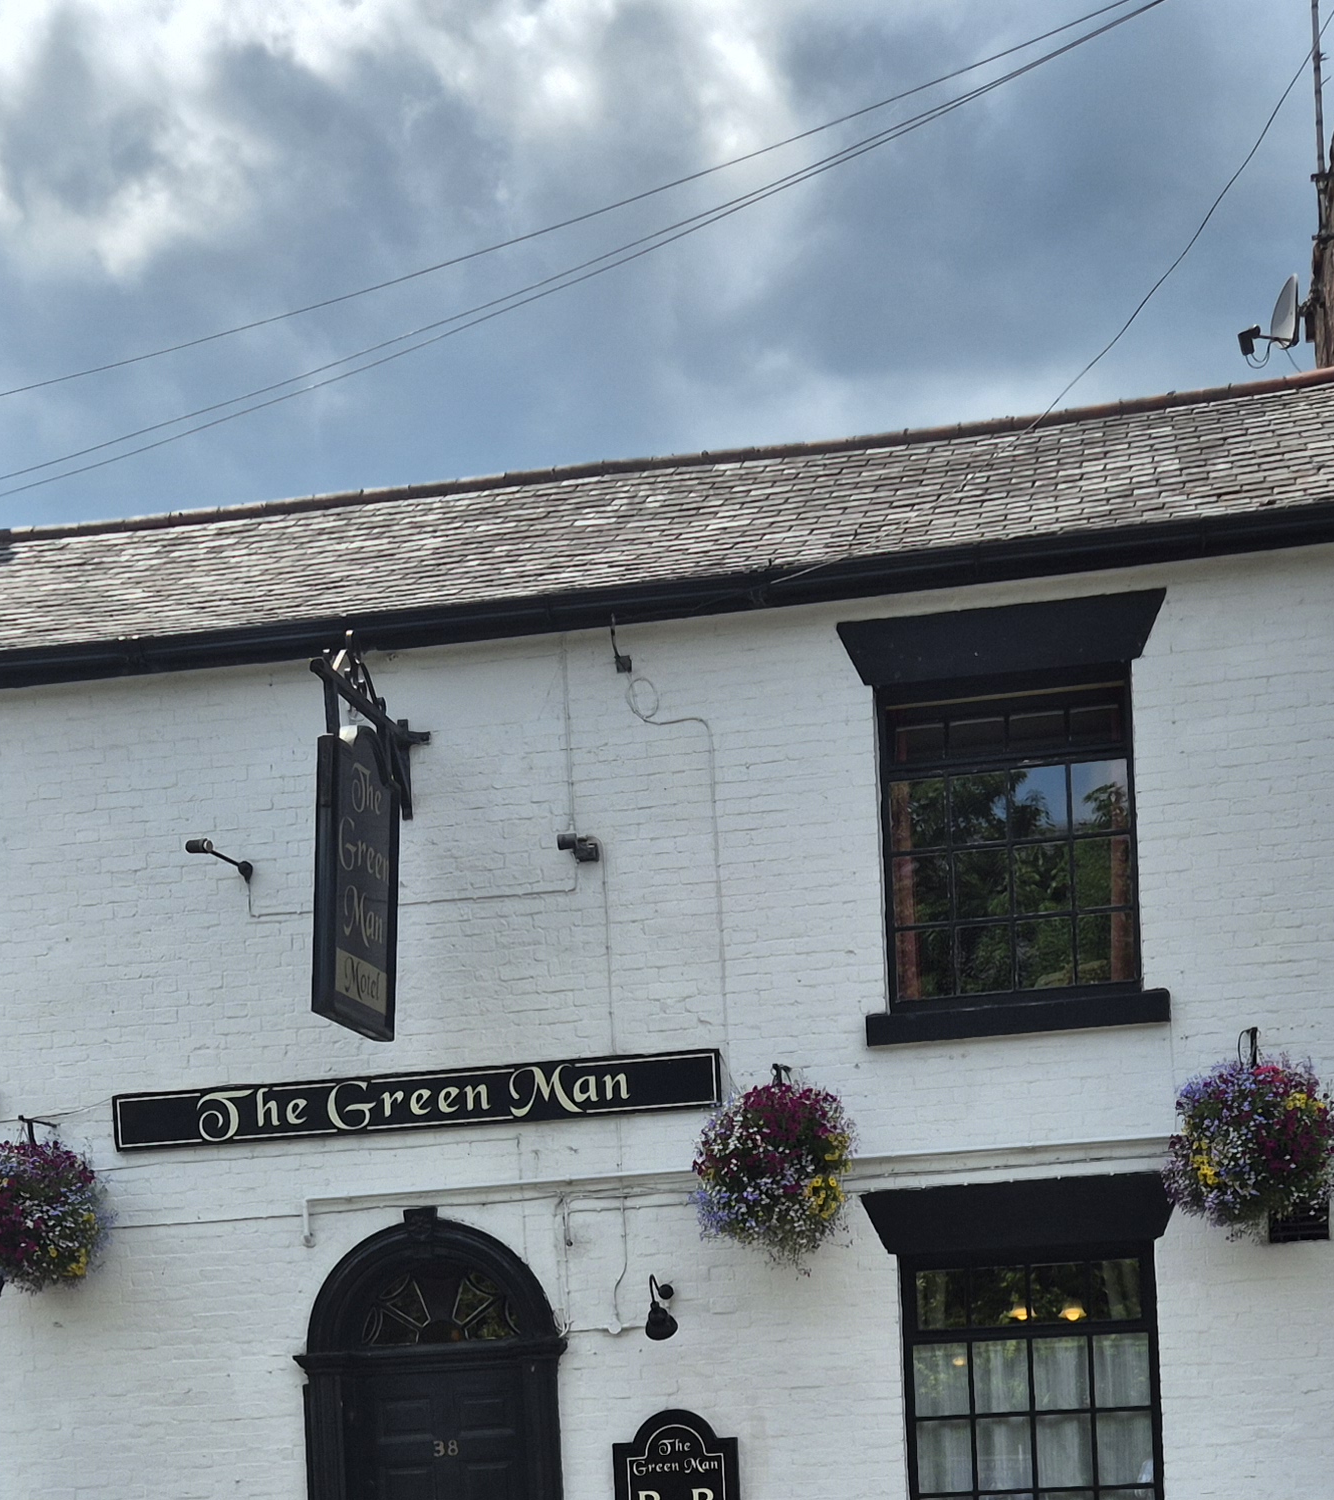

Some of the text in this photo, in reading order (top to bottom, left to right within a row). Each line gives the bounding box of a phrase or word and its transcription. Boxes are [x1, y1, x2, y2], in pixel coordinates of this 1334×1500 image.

[352, 762, 382, 815] The
[338, 816, 390, 887] Green
[343, 885, 383, 948] Man
[344, 956, 380, 1001] Motel
[196, 1064, 631, 1142] The Green Man
[433, 1439, 459, 1457] 38
[632, 1457, 719, 1476] Green Man
[658, 1438, 691, 1456] The
